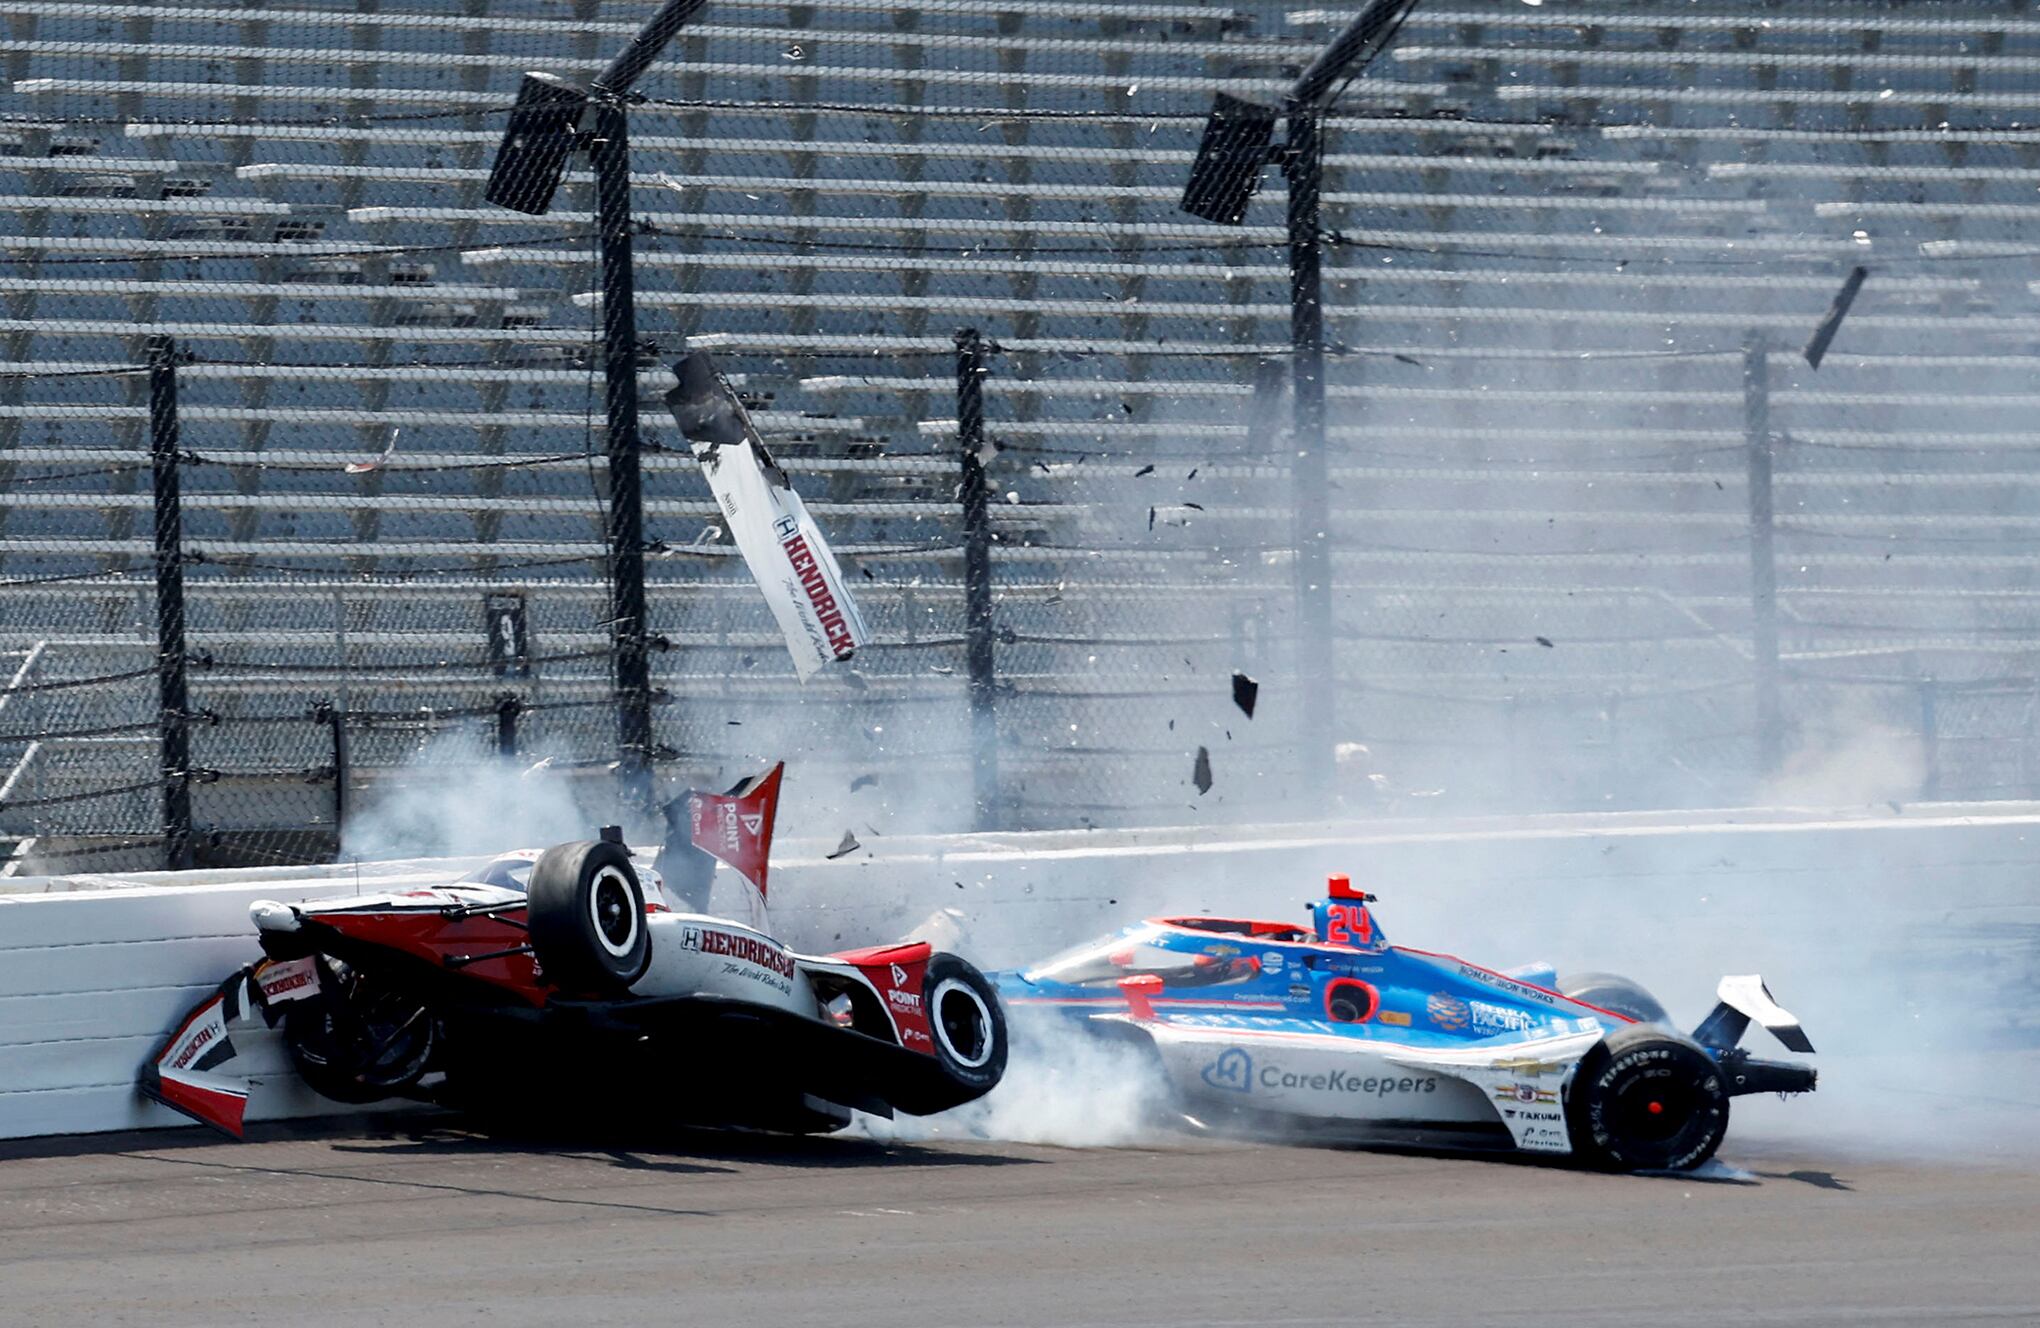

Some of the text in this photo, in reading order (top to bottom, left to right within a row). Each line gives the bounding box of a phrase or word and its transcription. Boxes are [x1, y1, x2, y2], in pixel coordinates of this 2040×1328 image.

[724, 803, 739, 853] POINT
[1327, 905, 1373, 943] 24
[701, 930, 796, 980] HENDRICKSON
[888, 990, 920, 1006] POINT
[1260, 1066, 1437, 1097] CareKeepers
[1598, 1049, 1670, 1088] Firestone
[1519, 1111, 1561, 1121] TAKUMI
